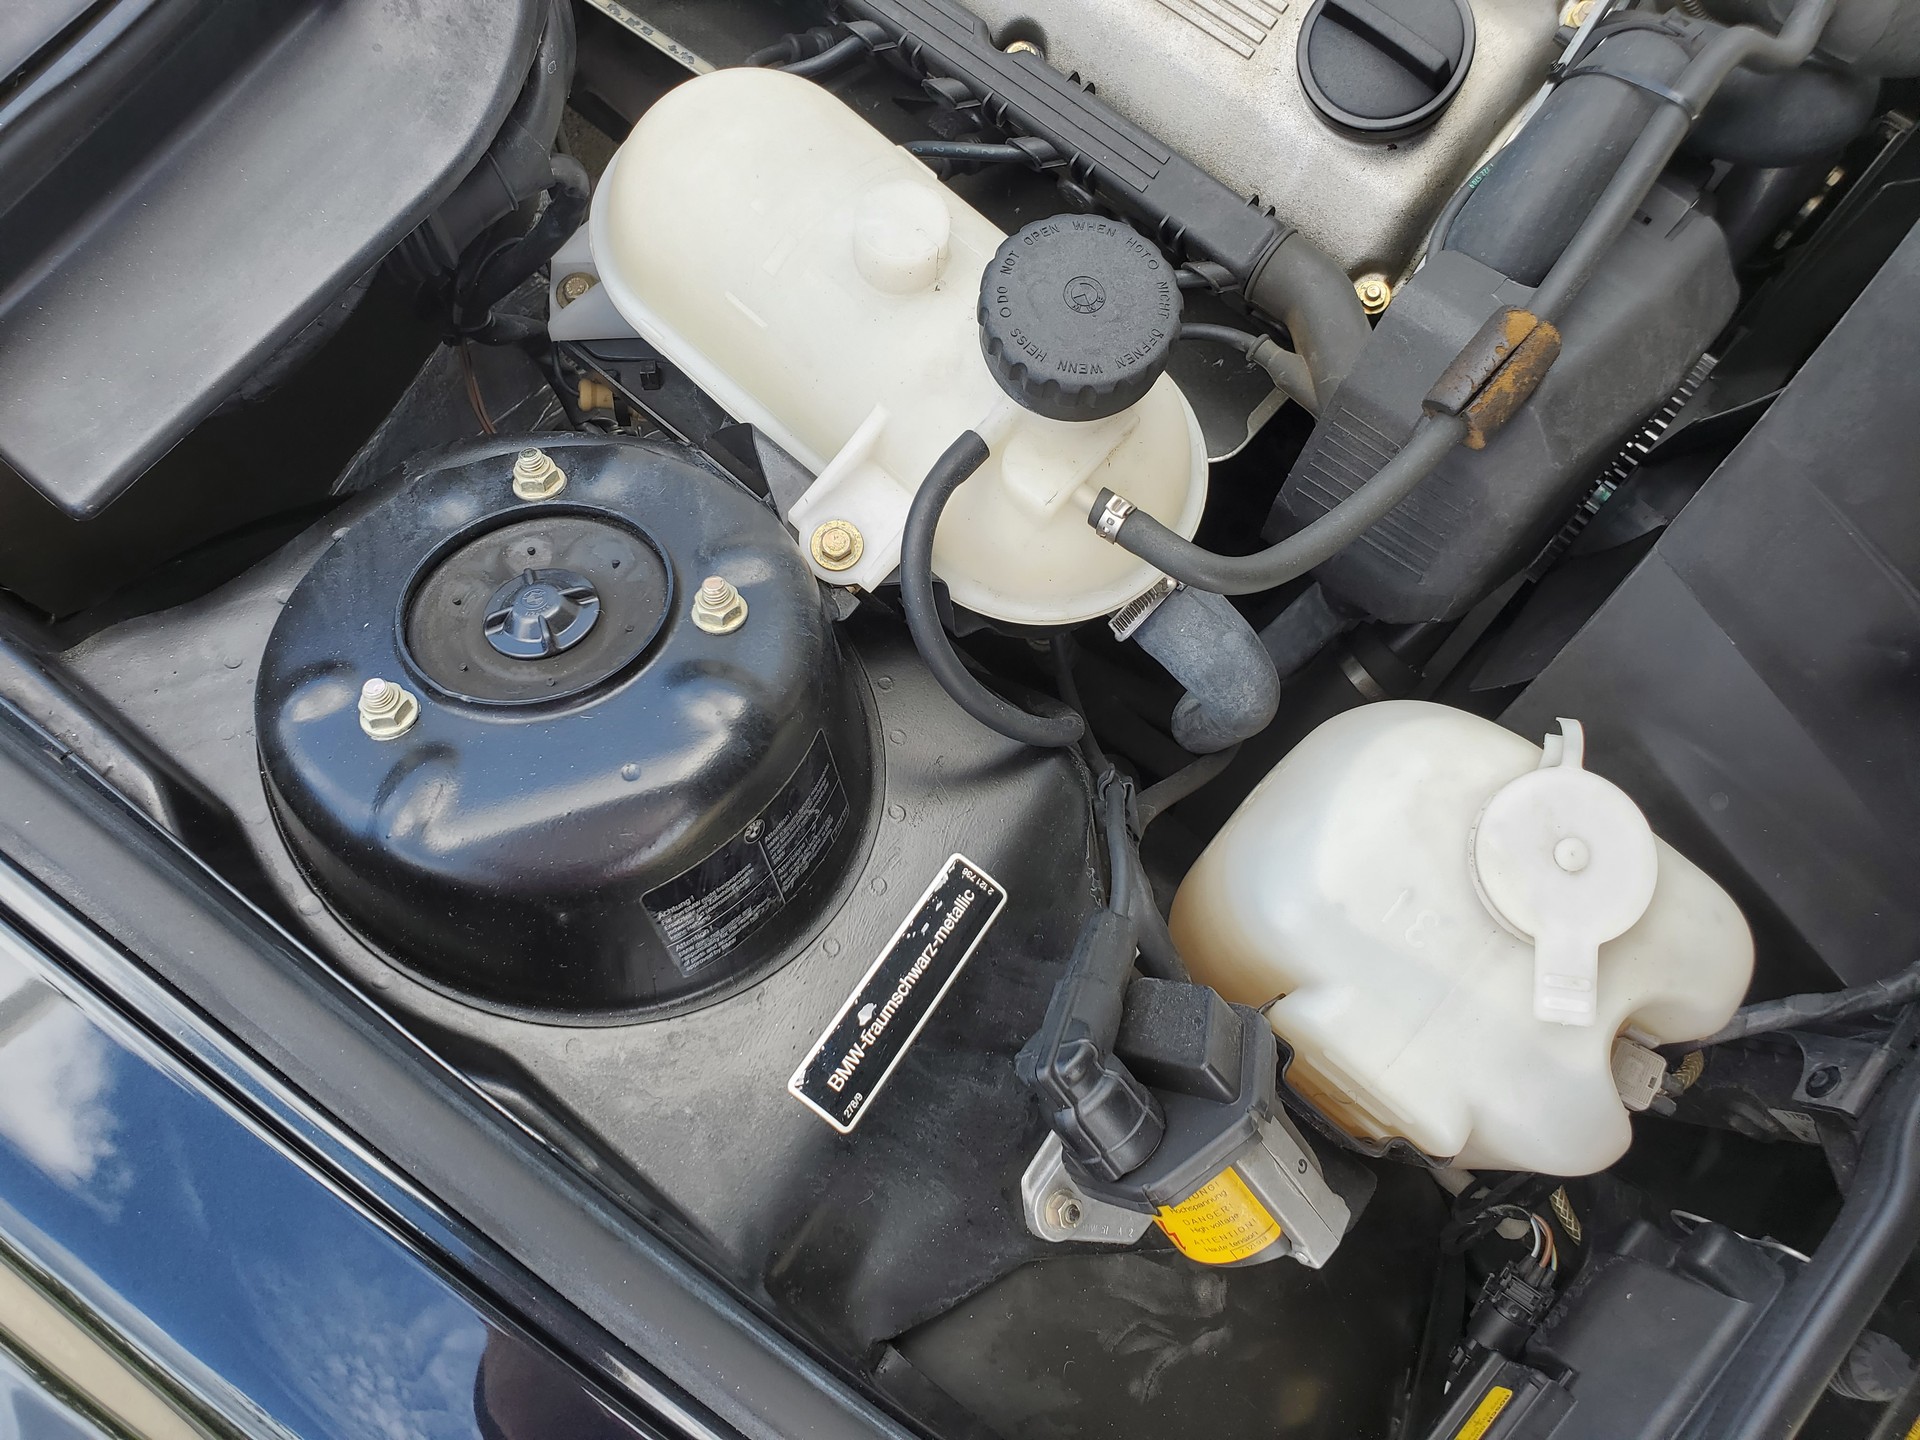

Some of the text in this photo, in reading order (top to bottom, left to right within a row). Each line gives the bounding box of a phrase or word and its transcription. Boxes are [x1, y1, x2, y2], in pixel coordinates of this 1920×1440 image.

[1000, 250, 1020, 275] NOT
[1023, 223, 1060, 246] OPEN
[1072, 220, 1117, 237] WHEN
[1010, 281, 1170, 375] NICHT ÖFFNEN WENN HEISS
[974, 877, 988, 890] 121
[986, 886, 994, 895] 2
[827, 887, 977, 1092] BMW-traumschwarz-metallic
[842, 1091, 864, 1118] 278/9
[1183, 1203, 1234, 1226] DANGER!
[1190, 1213, 1239, 1234] High voltage
[1194, 1218, 1257, 1245] ATTENTION!
[1229, 1231, 1258, 1247] tension
